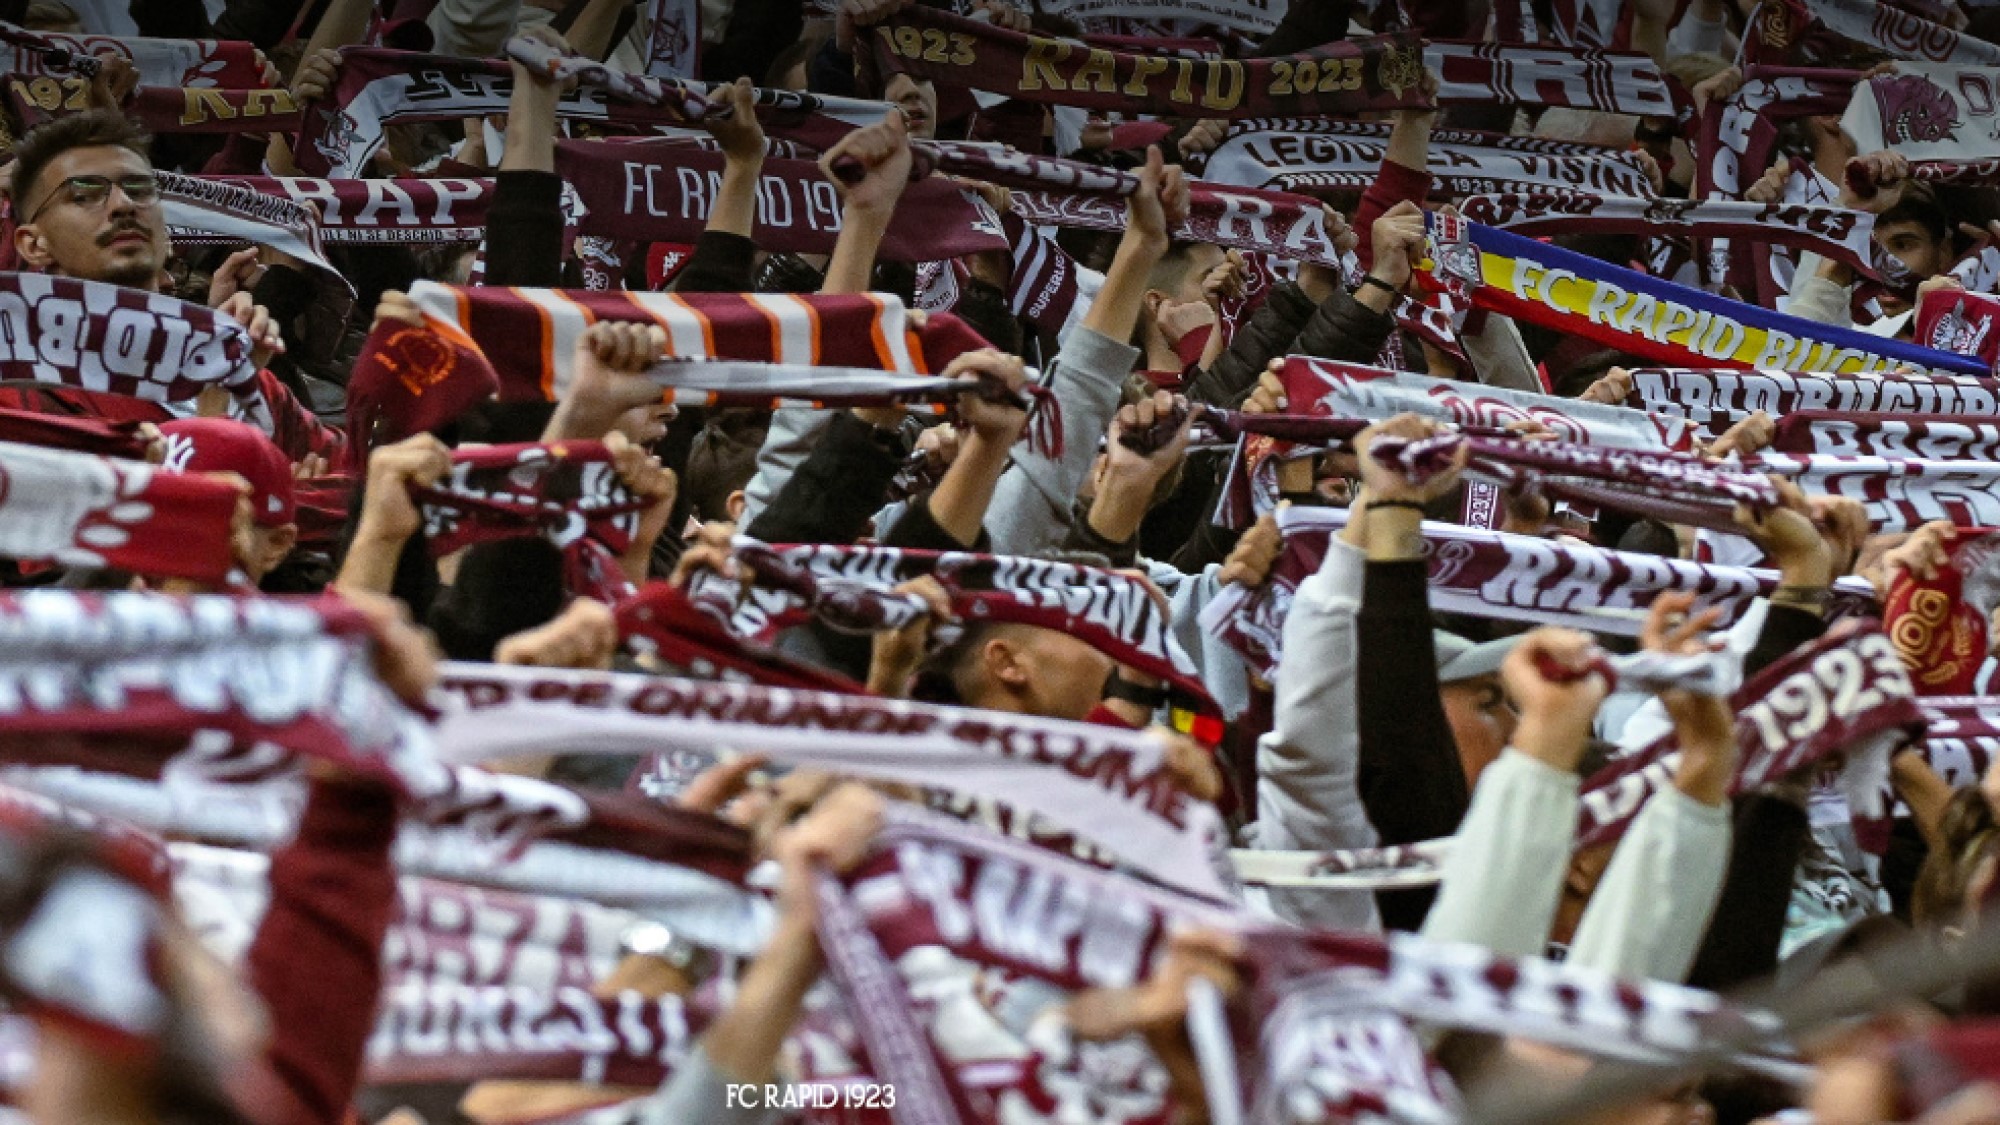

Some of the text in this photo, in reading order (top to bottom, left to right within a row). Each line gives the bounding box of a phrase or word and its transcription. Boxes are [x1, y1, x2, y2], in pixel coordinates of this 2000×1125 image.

[876, 25, 1363, 110] 1923 RAPID 2023
[279, 179, 484, 225] RAP
[623, 162, 668, 217] FC
[1512, 257, 1576, 314] FC
[1590, 279, 1746, 361] RAPID
[1738, 633, 1915, 752] 1923
